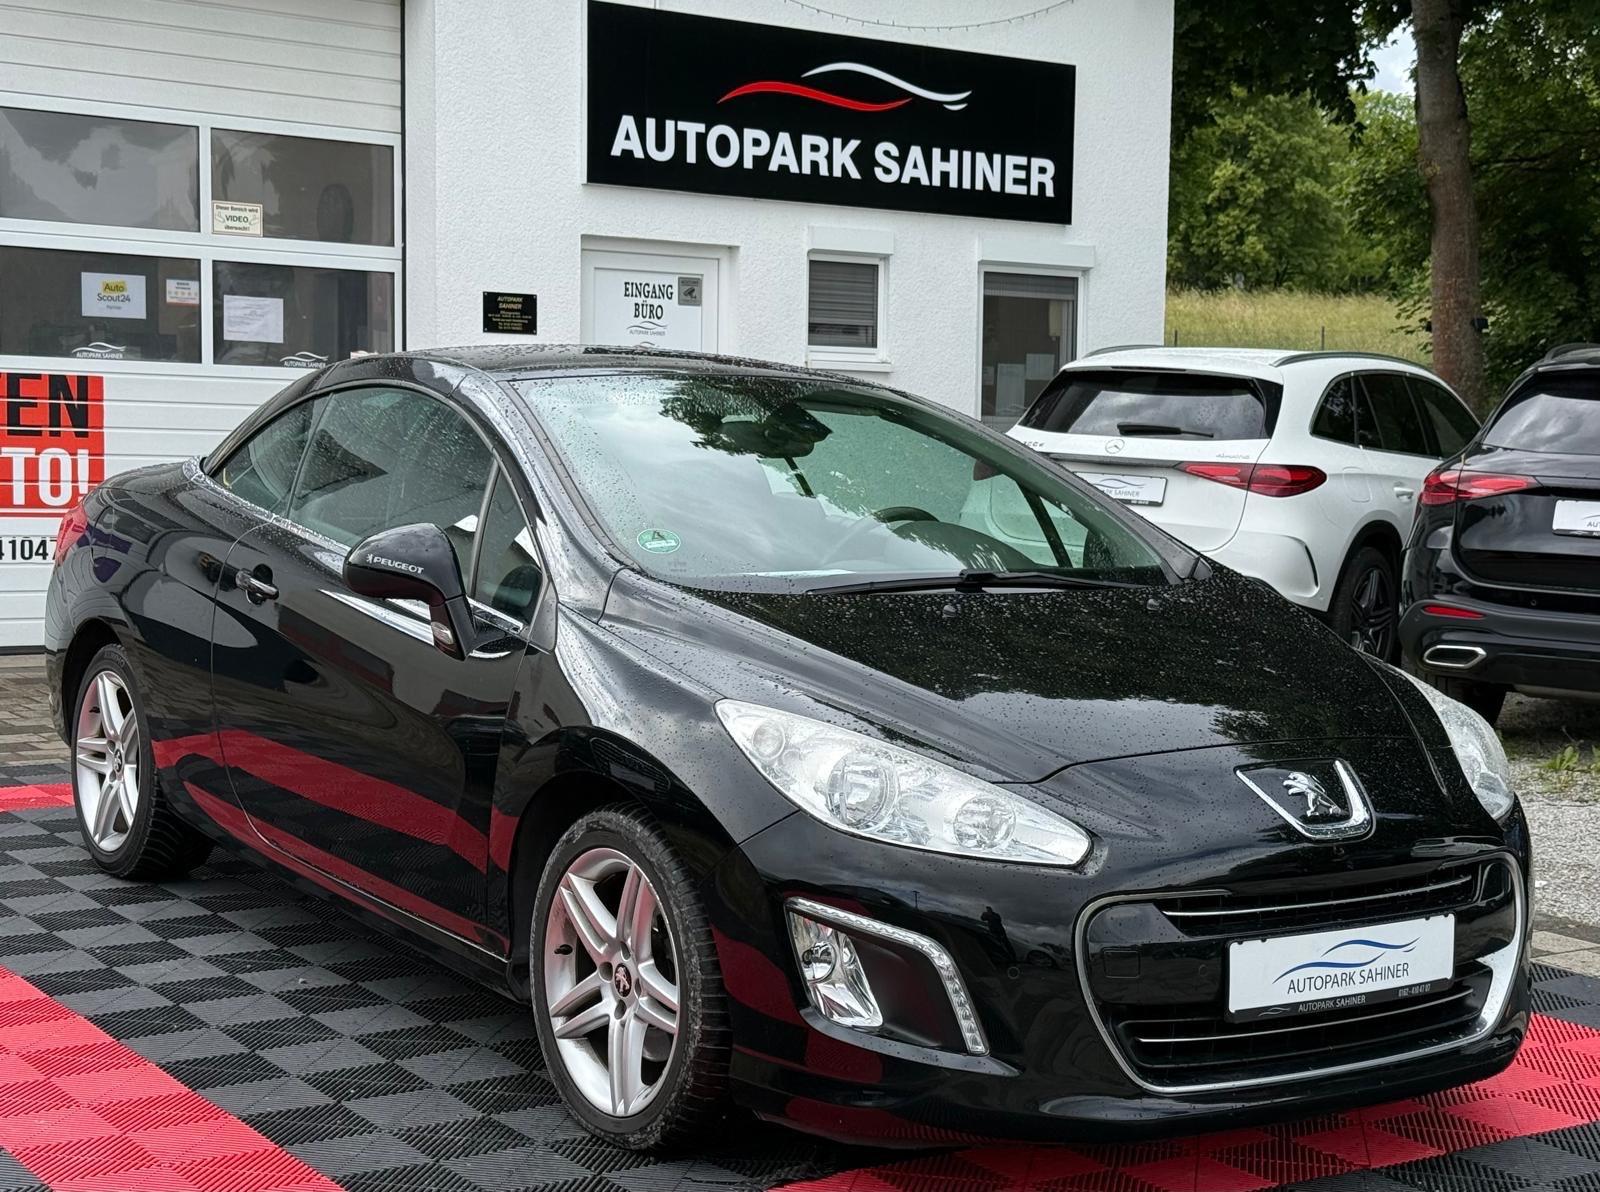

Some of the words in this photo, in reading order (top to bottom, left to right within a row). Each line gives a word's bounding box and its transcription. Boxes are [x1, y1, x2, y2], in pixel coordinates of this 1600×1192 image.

[611, 114, 862, 180] AUTOPARK
[874, 141, 1056, 198] SAHINER
[225, 214, 249, 223] VIDEO
[104, 282, 125, 293] Auto
[624, 281, 674, 300] EINGANG
[97, 292, 131, 302] Scout24
[634, 300, 664, 320] BÜRO
[76, 351, 102, 359] AUTOPARK
[284, 360, 307, 368] AUTOPARK
[307, 361, 326, 369] SAHINER
[0, 373, 89, 438] EN
[373, 556, 424, 574] PEUGEOT
[1287, 970, 1356, 994] AUTOPARK
[1358, 962, 1410, 985] SAHINER
[1298, 999, 1335, 1012] AUTOPARK
[1335, 995, 1366, 1008] SAHINER
